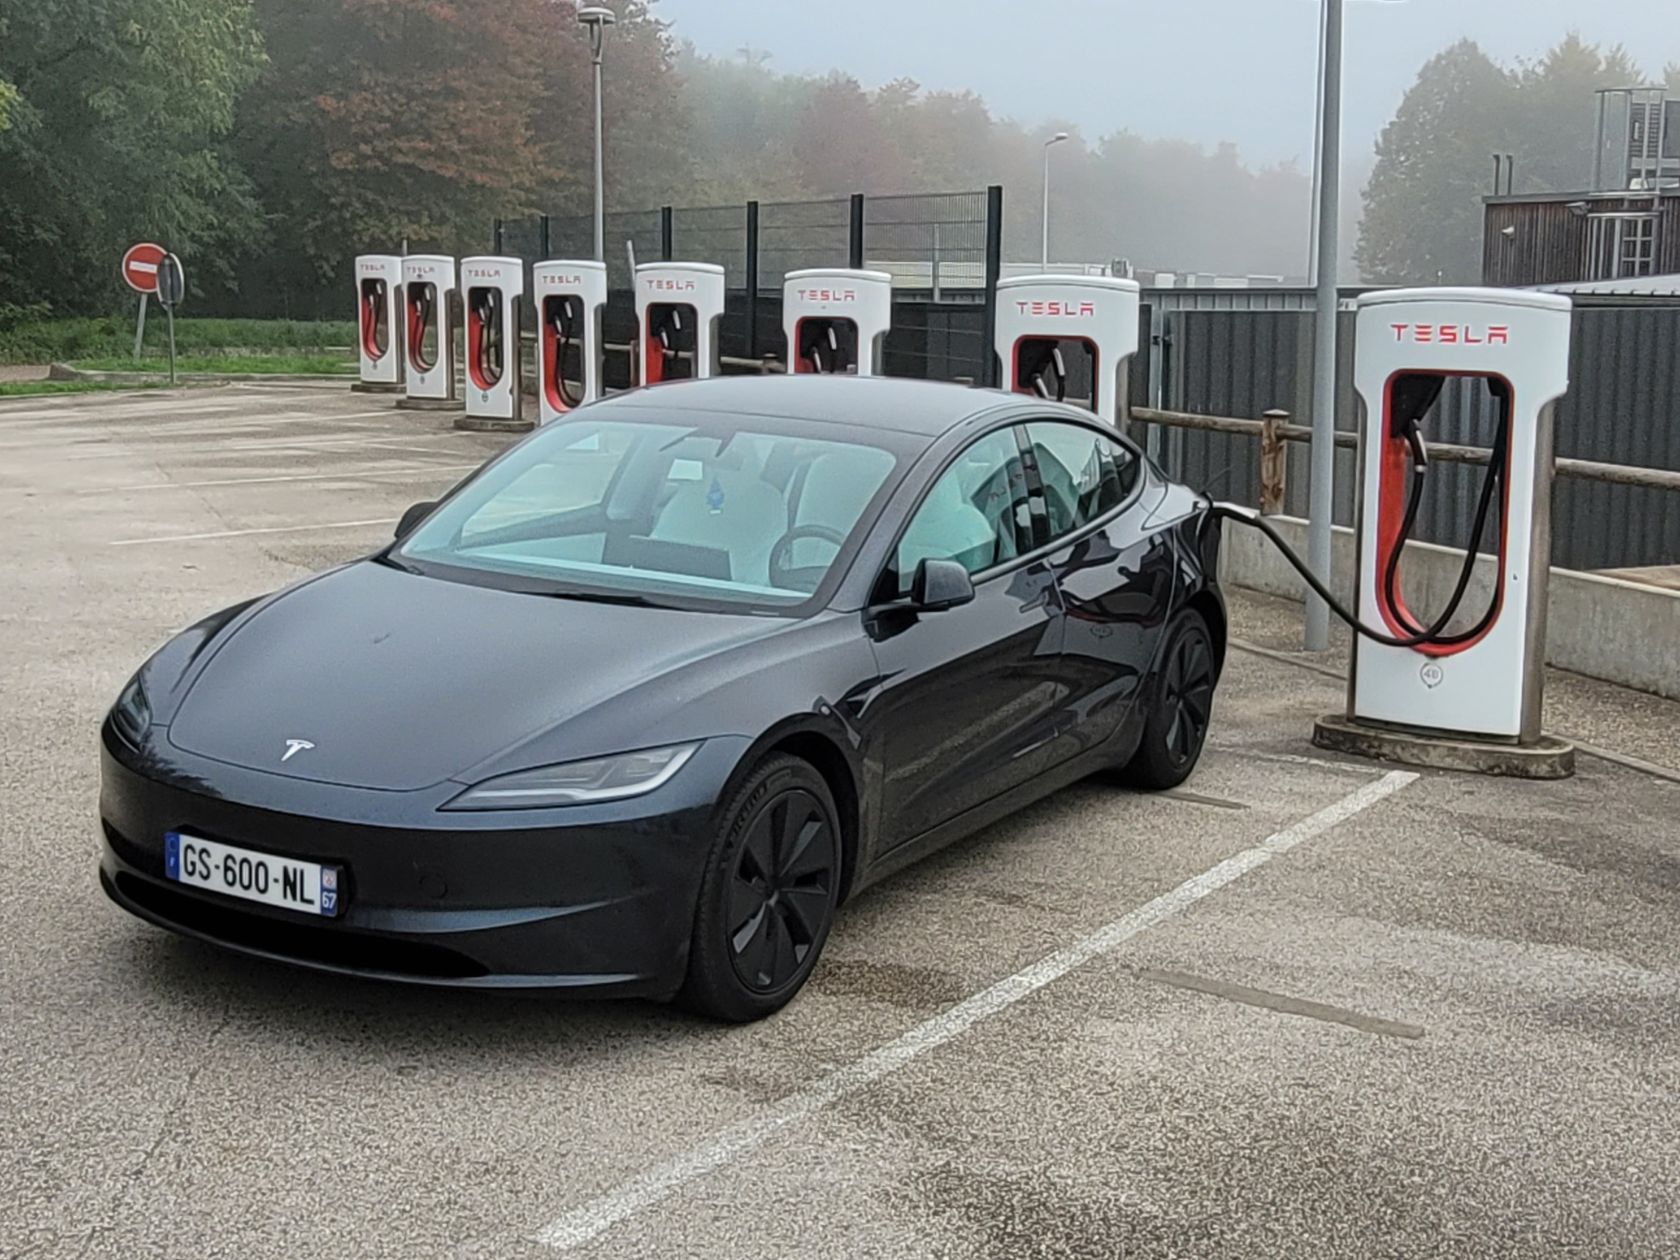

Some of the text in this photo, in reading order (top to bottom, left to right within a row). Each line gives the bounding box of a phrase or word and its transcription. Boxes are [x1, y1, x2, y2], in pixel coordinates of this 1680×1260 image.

[542, 275, 581, 284] TESLA
[647, 280, 694, 290] TESLA
[798, 290, 854, 301] TESLA
[1016, 302, 1094, 316] TESLA
[1390, 324, 1508, 344] TESLA
[183, 844, 314, 905] GS-600-NL
[322, 891, 336, 908] 67
